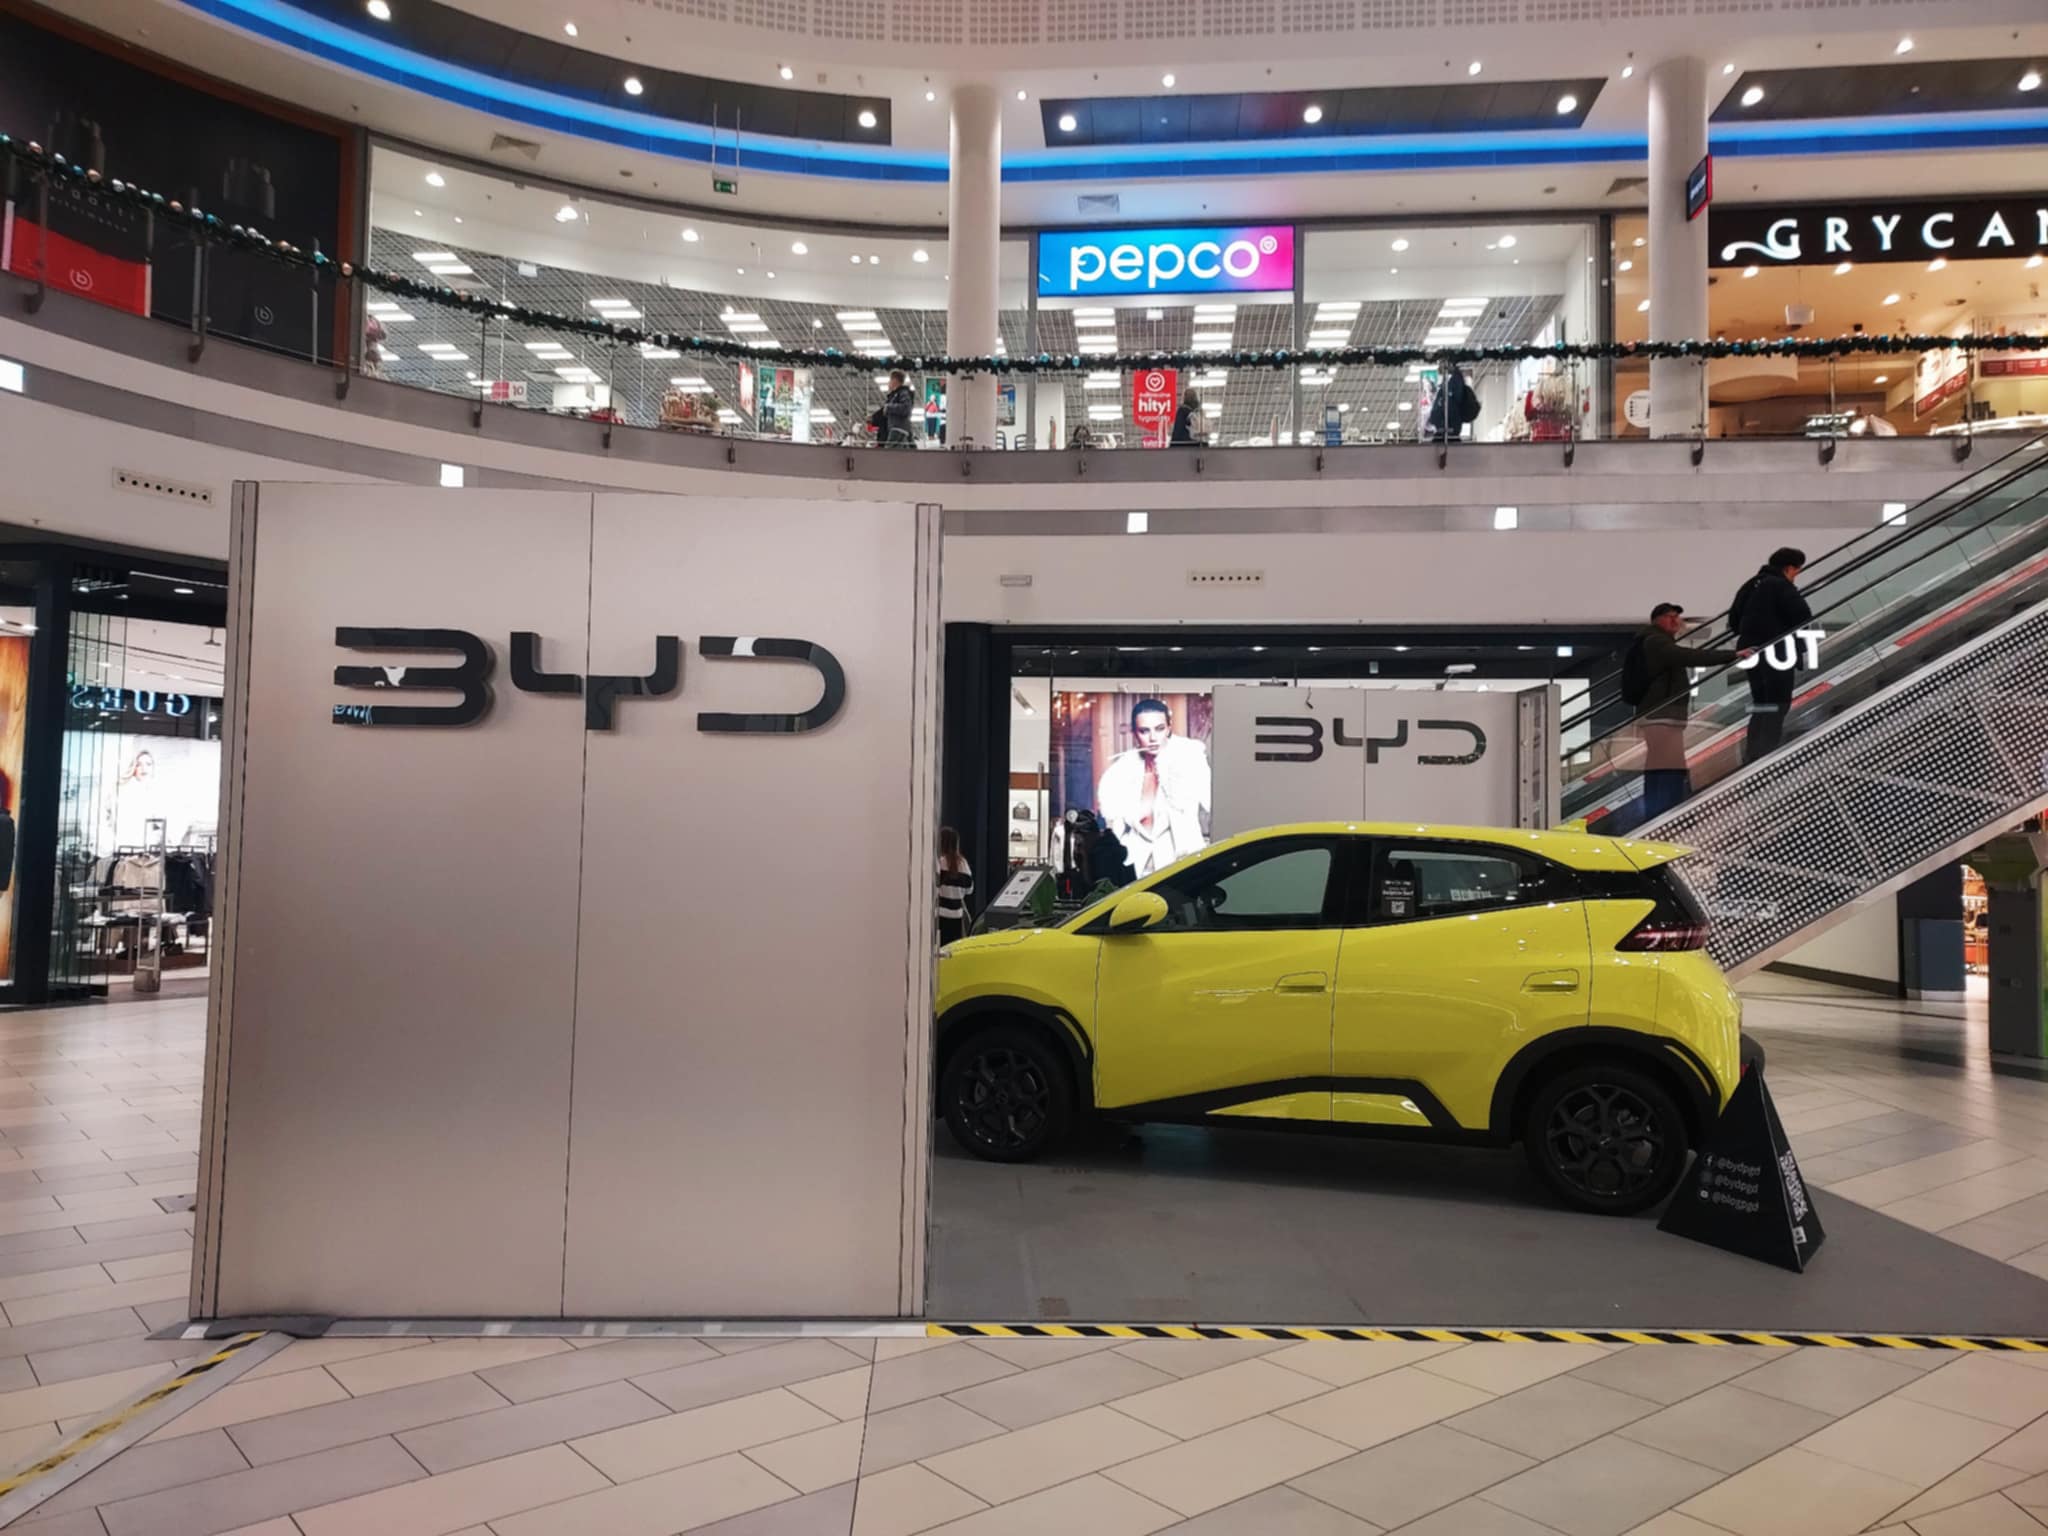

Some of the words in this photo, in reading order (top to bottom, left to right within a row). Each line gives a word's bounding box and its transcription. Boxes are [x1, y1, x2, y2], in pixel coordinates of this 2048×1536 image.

[1070, 240, 1260, 290] pepco
[1138, 397, 1172, 415] hity!
[333, 627, 847, 733] BYD
[1255, 717, 1487, 765] BYD
